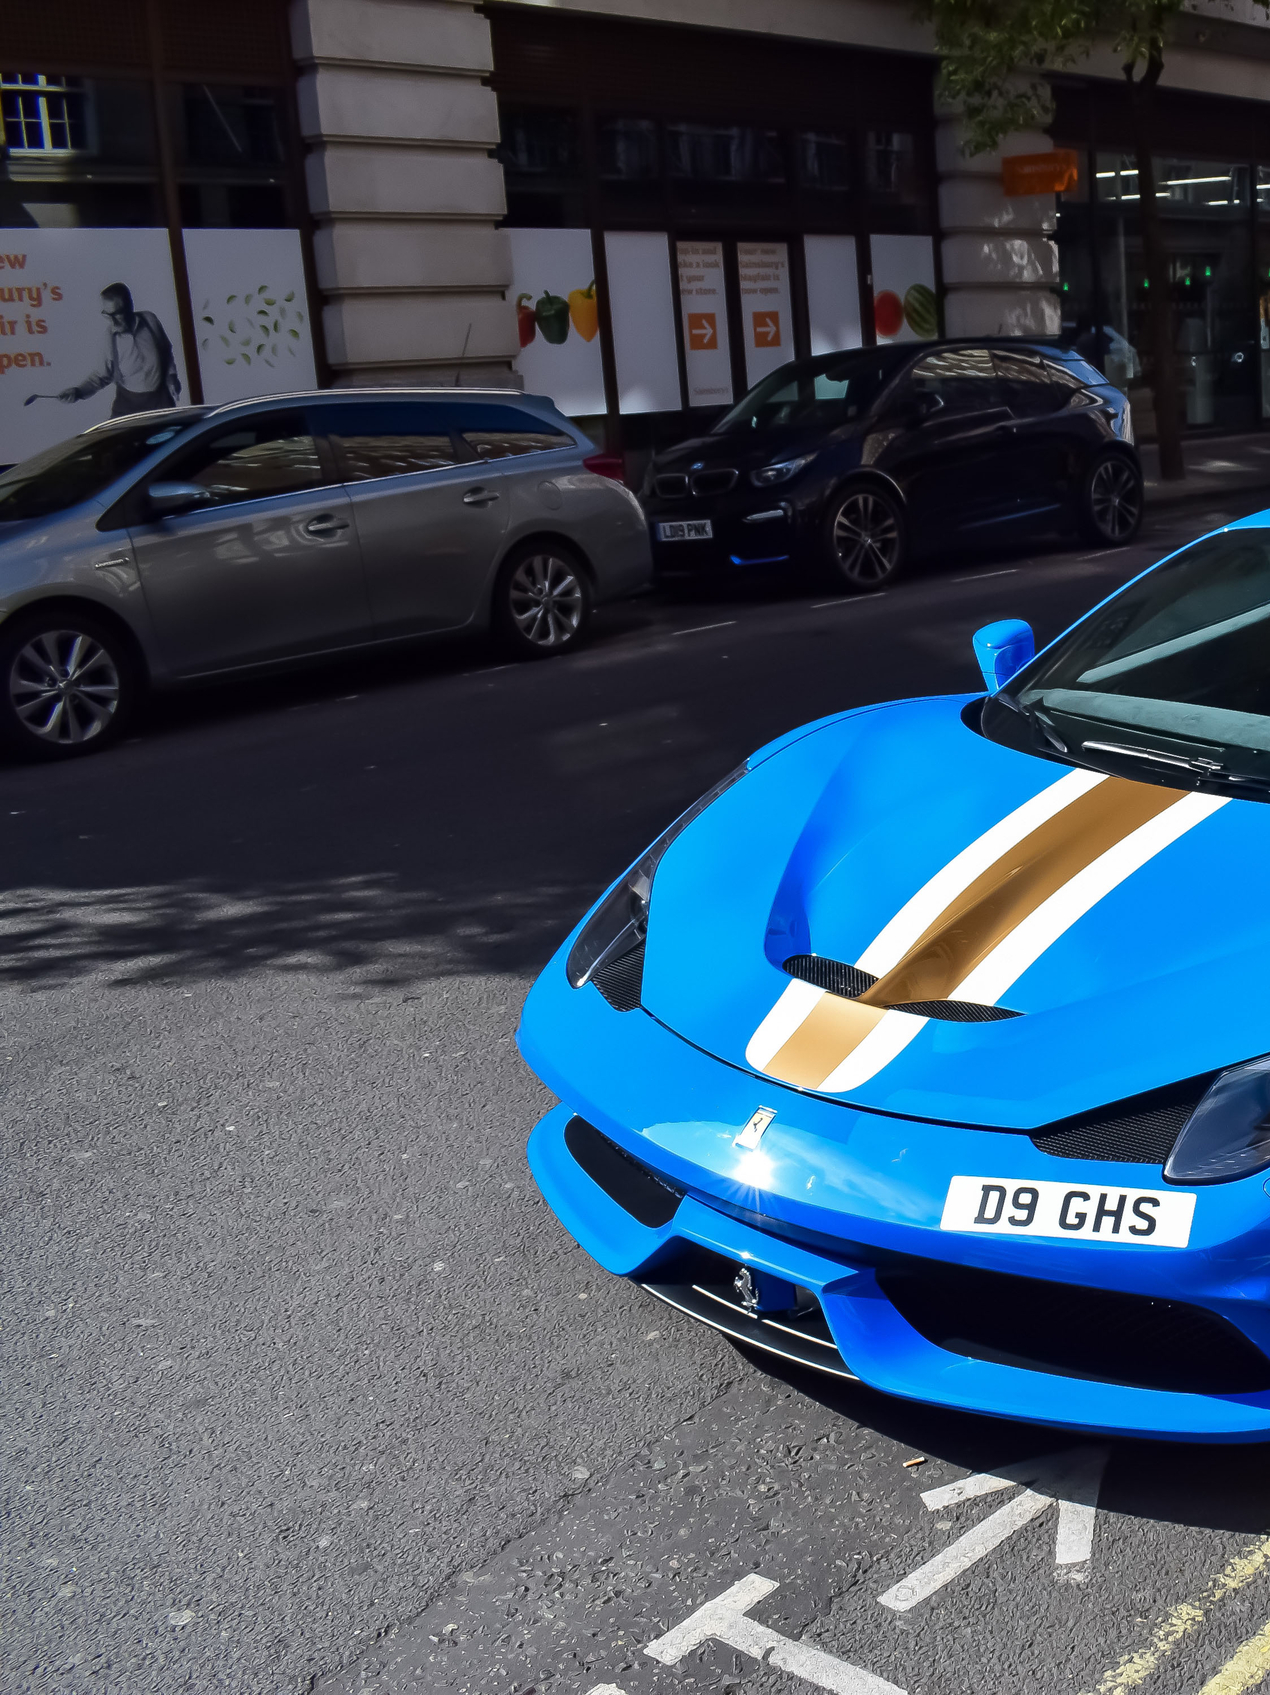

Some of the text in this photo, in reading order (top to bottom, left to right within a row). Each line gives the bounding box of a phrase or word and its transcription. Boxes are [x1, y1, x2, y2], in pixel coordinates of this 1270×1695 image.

[25, 314, 48, 335] is
[974, 1184, 1161, 1237] D9 GHS
